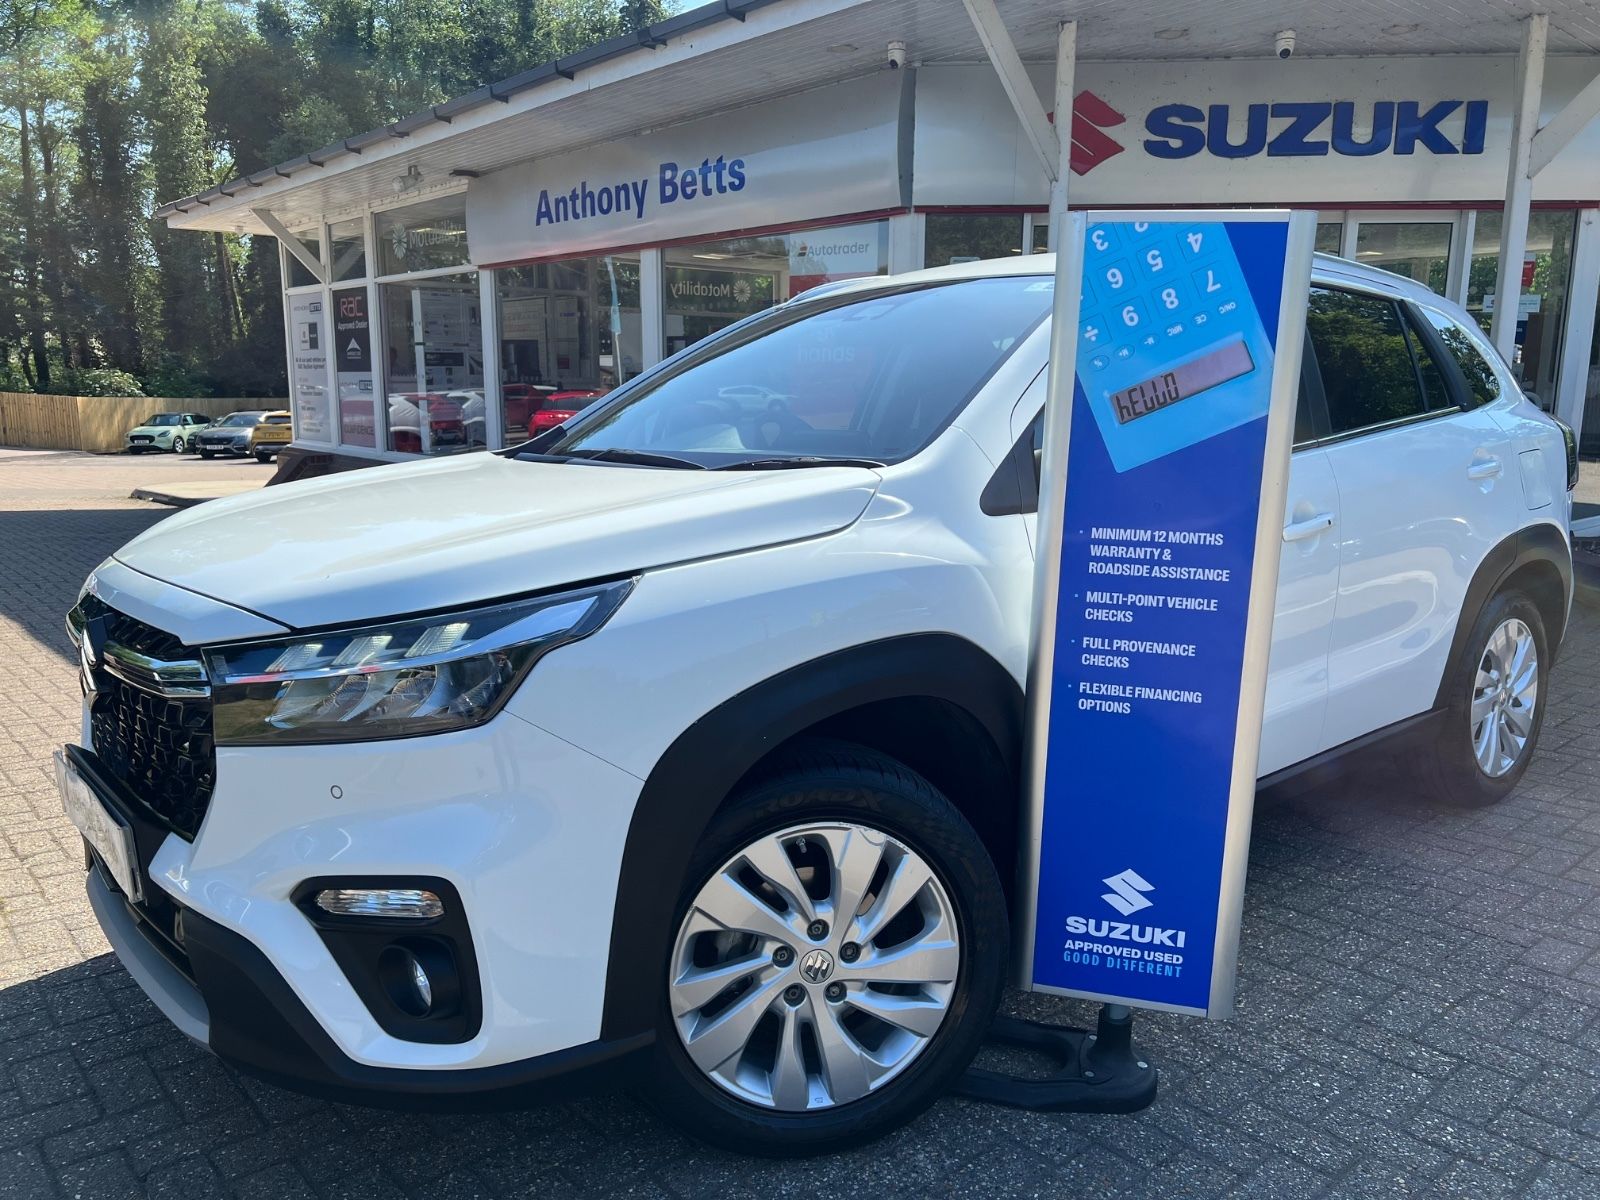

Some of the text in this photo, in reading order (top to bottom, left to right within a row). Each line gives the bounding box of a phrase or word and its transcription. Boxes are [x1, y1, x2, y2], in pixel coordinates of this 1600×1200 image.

[1143, 100, 1489, 159] SUZUKI
[535, 154, 746, 227] Anthony Betts
[807, 242, 870, 257] Autotrader
[1187, 232, 1203, 253] 4
[1146, 249, 1163, 272] 5
[1206, 269, 1221, 293] 7
[1162, 288, 1179, 309] 8
[1091, 527, 1224, 546] MINIMUM 12 MONTHS
[1090, 544, 1172, 561] WARRANTY &
[1088, 562, 1231, 582] ROADSIDE ASSISTANCE
[1086, 591, 1218, 611] MULTI-POINT VEHICLE
[1085, 608, 1134, 623] CHECKS
[1082, 636, 1196, 657] FULL PROVENANCE
[1081, 653, 1130, 668] CHECKS
[1079, 682, 1202, 704] FLEXIBLE FINANCING
[1078, 698, 1131, 714] OPTIONS
[1065, 916, 1186, 948] SUZUKI
[1064, 939, 1184, 965] APPROVED USED
[1063, 950, 1183, 978] GOOD DIFFERENT
